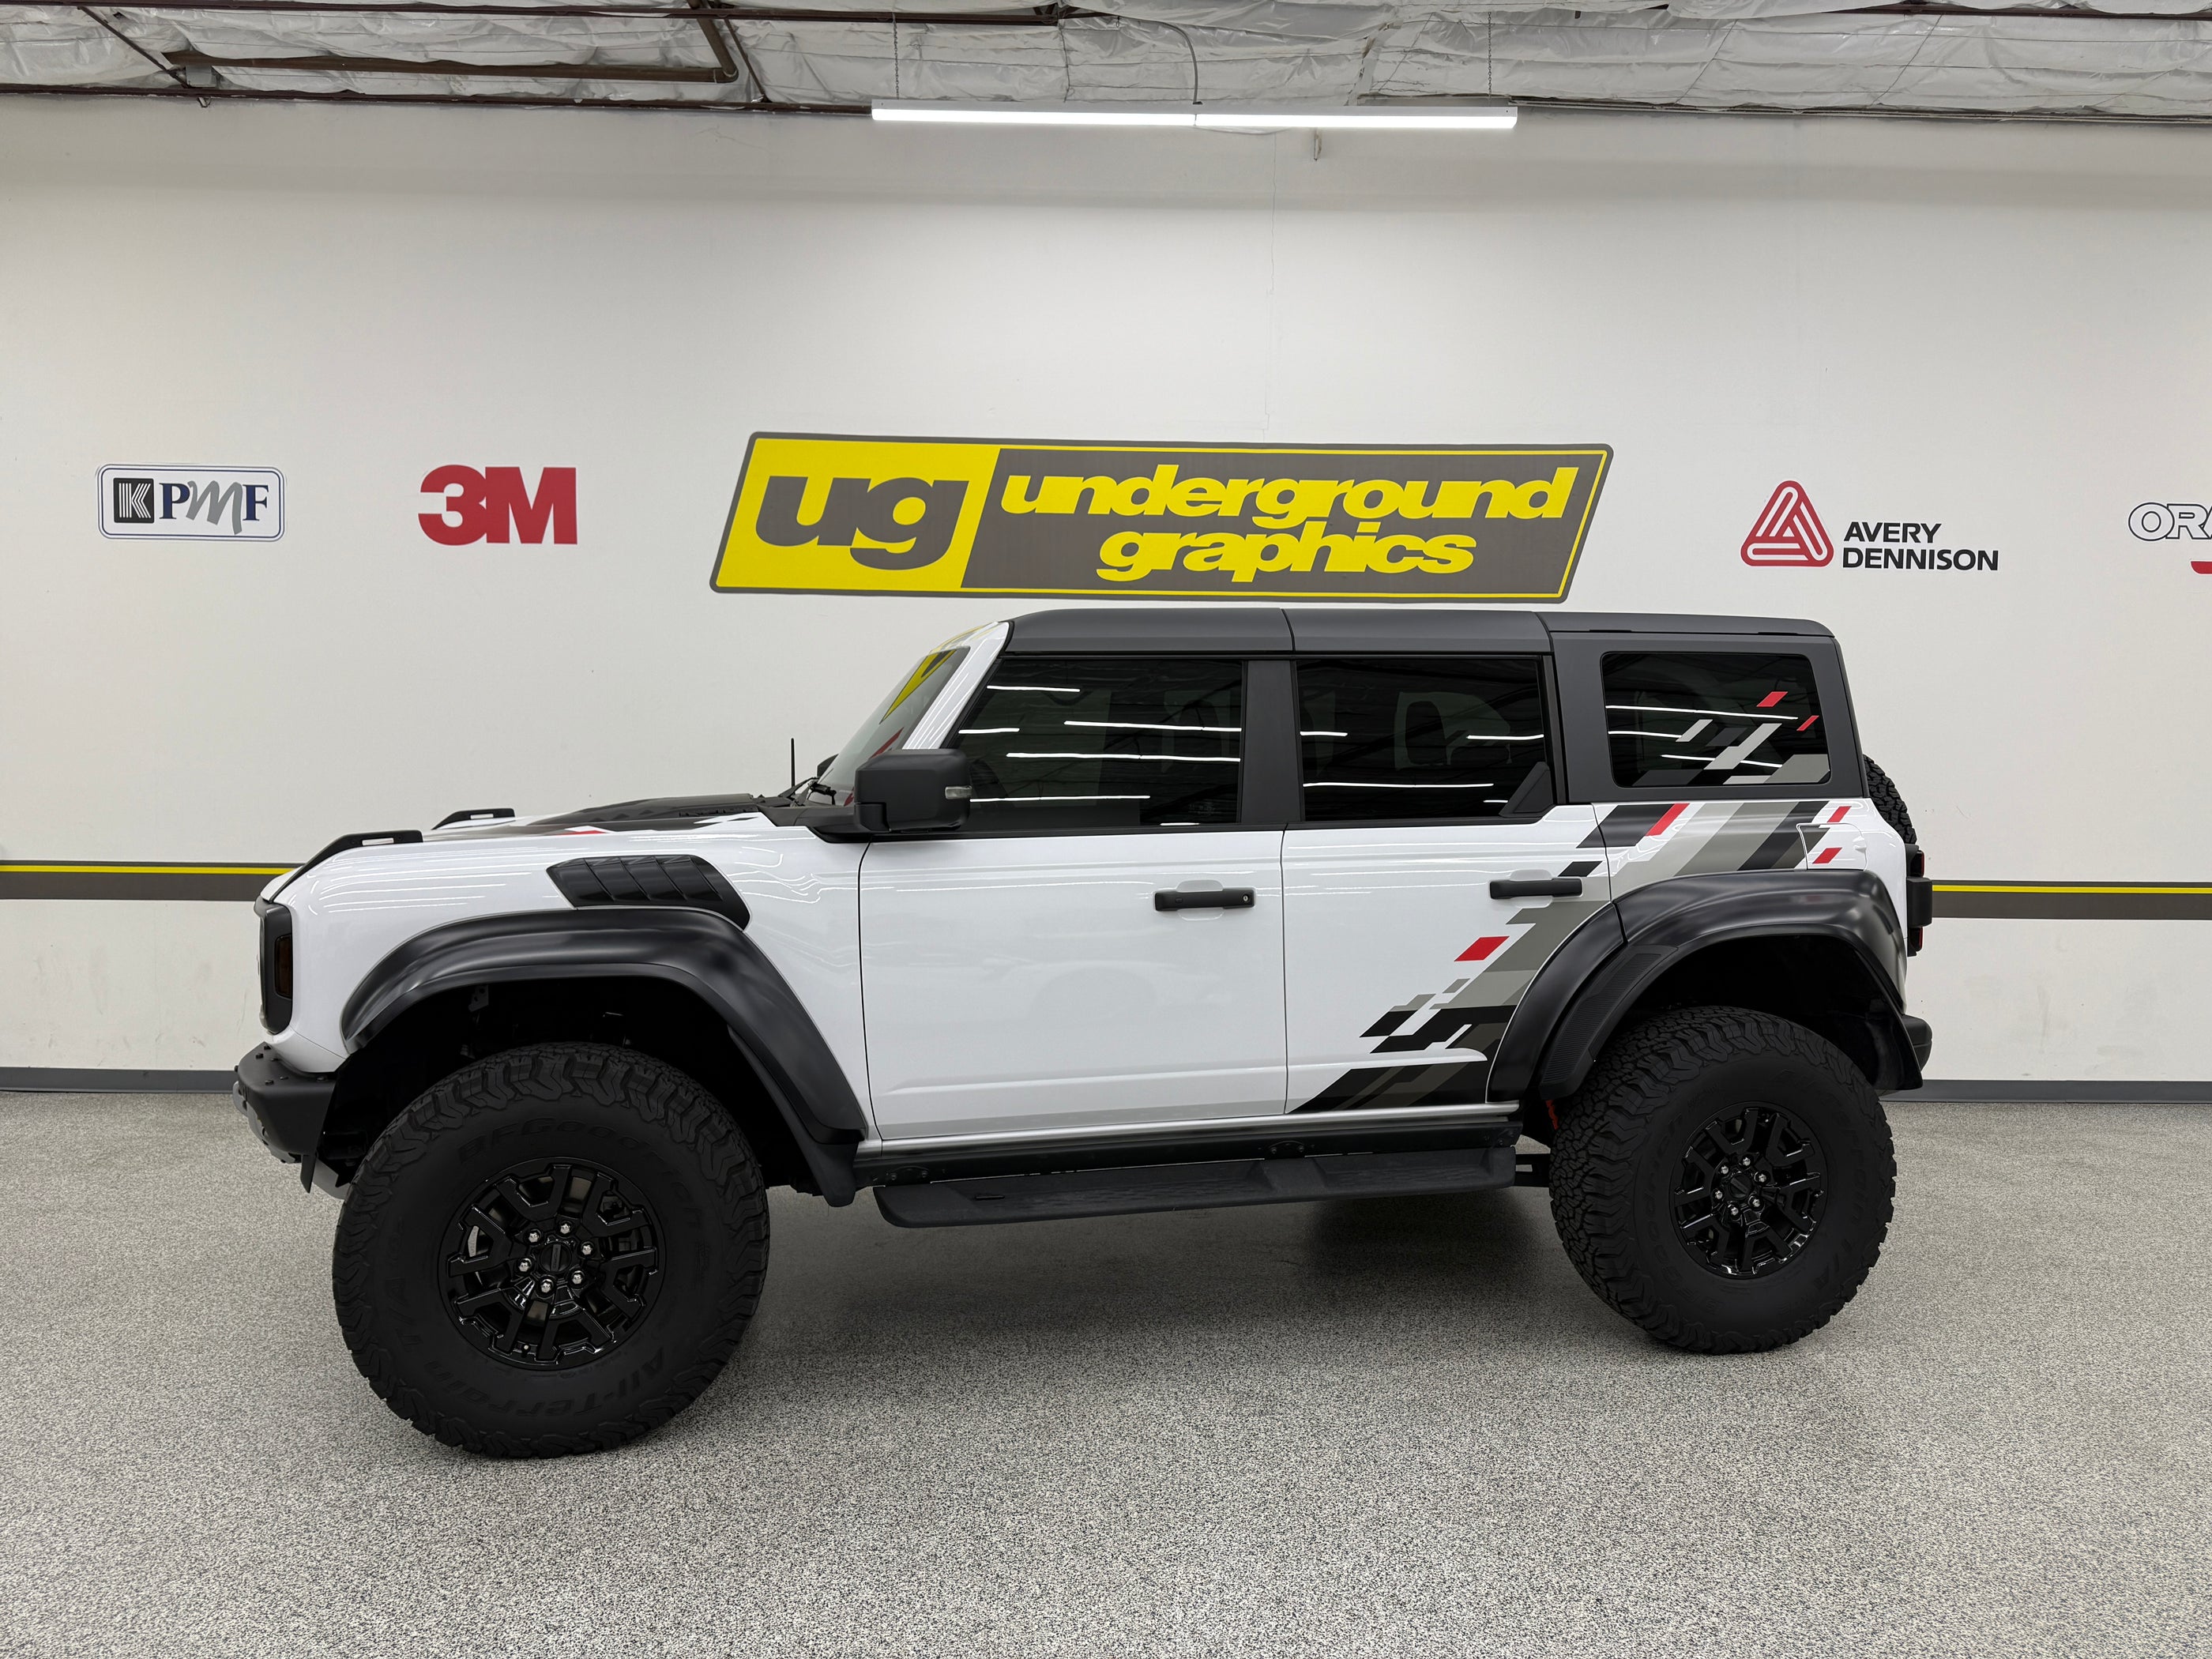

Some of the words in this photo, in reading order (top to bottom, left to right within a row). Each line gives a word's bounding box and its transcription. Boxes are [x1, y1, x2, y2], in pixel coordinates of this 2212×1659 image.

[418, 465, 578, 547] 3M
[755, 476, 969, 570] ug
[1001, 465, 1579, 529] underground
[2128, 502, 2212, 542] OR
[1096, 521, 1477, 583] graphics
[1842, 547, 1999, 571] DENNISON
[1843, 521, 1942, 544] AVERY
